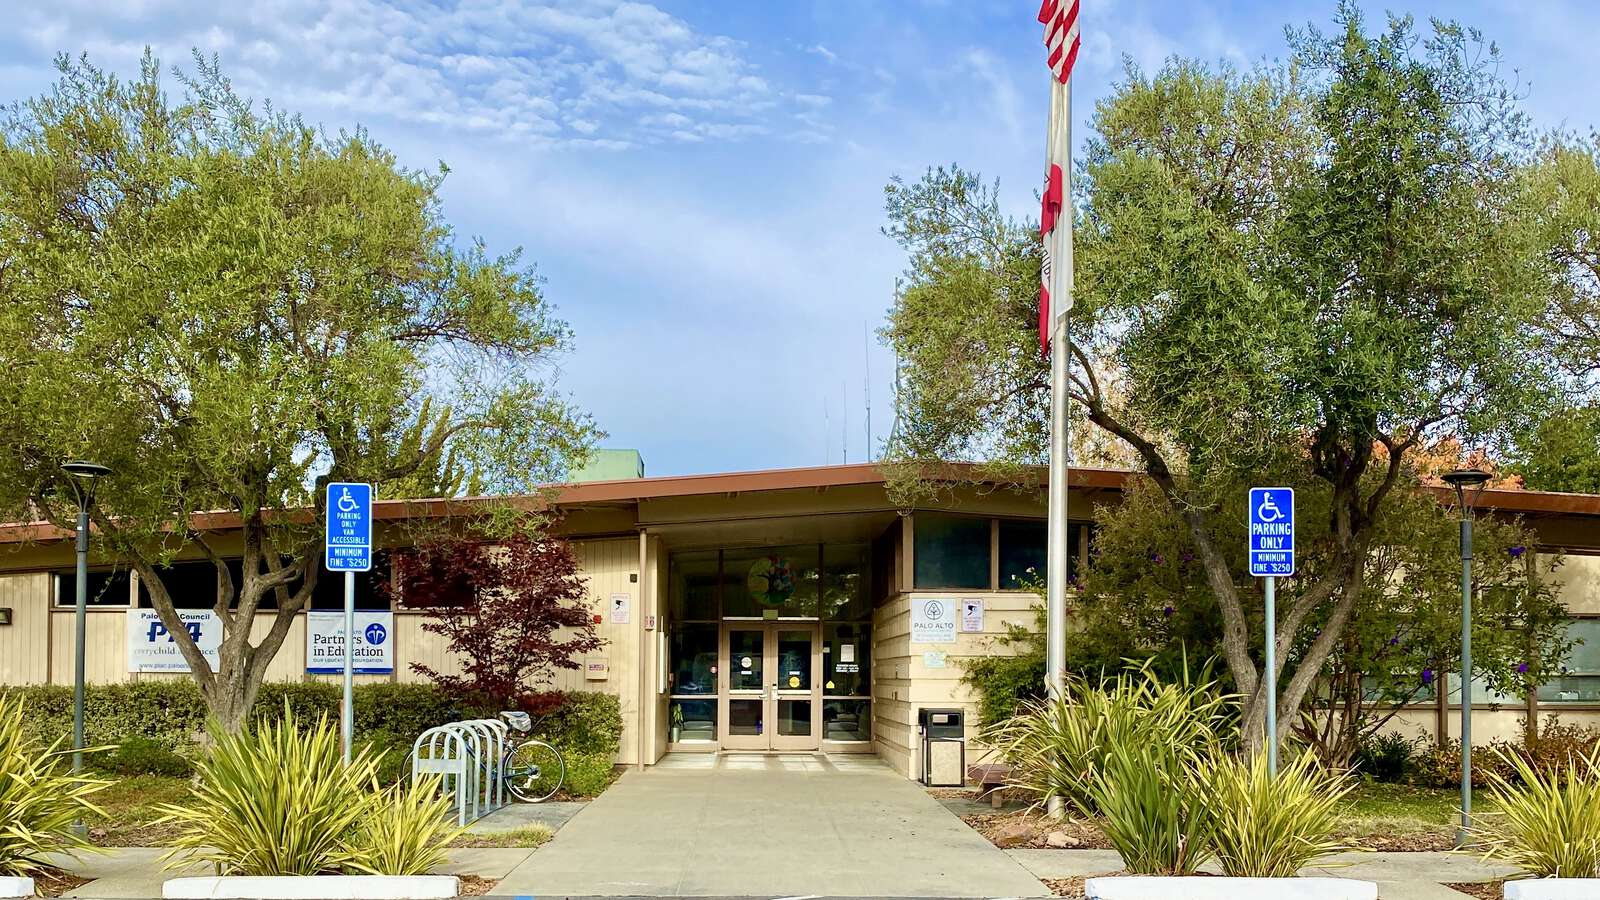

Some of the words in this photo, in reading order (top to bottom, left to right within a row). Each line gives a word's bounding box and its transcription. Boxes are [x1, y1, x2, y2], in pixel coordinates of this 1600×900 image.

[337, 512, 361, 520] PARKING
[341, 520, 356, 528] ONLY
[1252, 522, 1291, 535] PARKING
[343, 528, 355, 536] VAN
[331, 536, 366, 544] ACCESSIBLE
[1260, 536, 1284, 549] ONLY
[334, 547, 363, 557] MINIMUM
[329, 557, 344, 567] FINE
[1258, 553, 1286, 562] MINIMUM
[1253, 563, 1268, 573] FINE
[146, 621, 203, 643] PA
[313, 633, 362, 645] Partnrs
[313, 646, 325, 657] in
